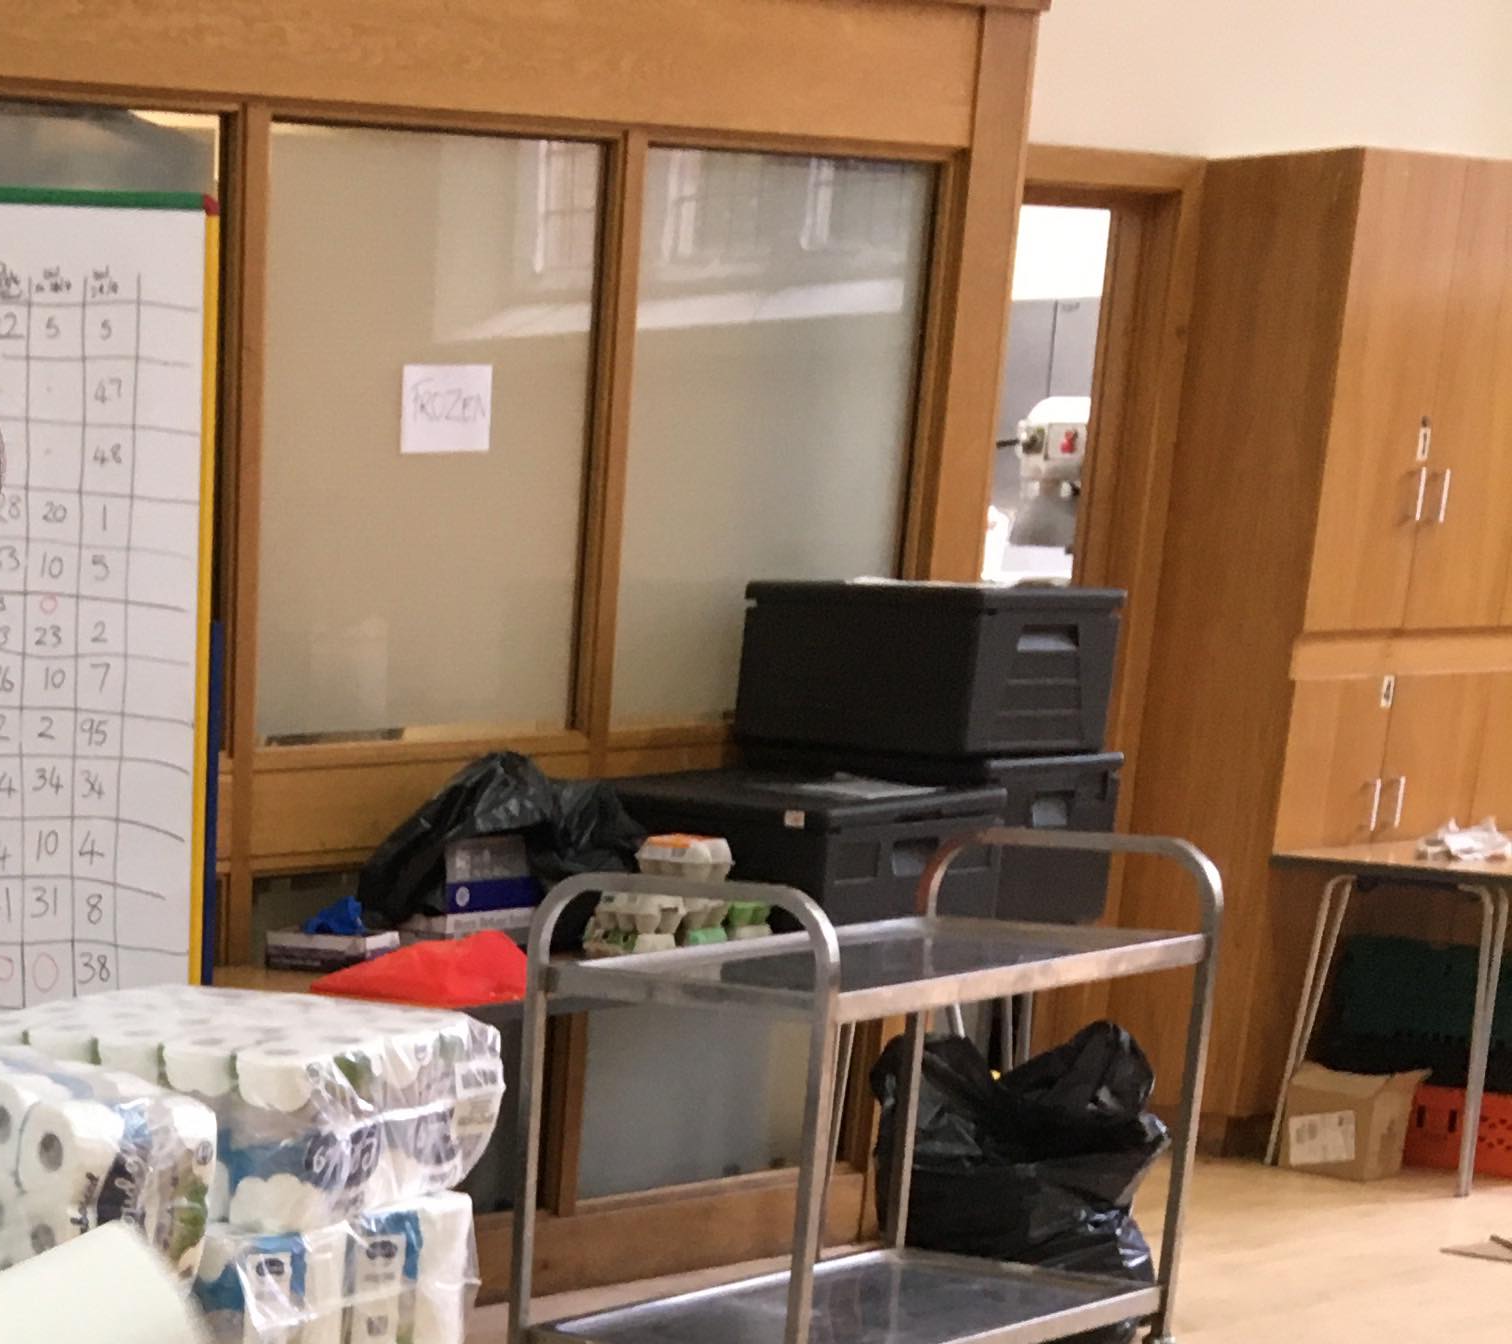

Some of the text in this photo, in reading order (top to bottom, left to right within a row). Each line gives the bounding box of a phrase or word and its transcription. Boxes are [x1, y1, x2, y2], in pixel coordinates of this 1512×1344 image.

[94, 379, 121, 404] 47
[42, 502, 67, 524] 20
[41, 554, 64, 579] 10
[34, 626, 62, 646] 23
[90, 622, 108, 643] 2
[44, 668, 65, 689] 10
[38, 717, 54, 739] 2
[33, 767, 64, 795] 34
[36, 830, 59, 862] 10
[79, 828, 105, 859] 4
[31, 886, 58, 919] 31
[87, 893, 104, 925] 8
[32, 953, 59, 993] 0
[79, 953, 111, 984] 38
